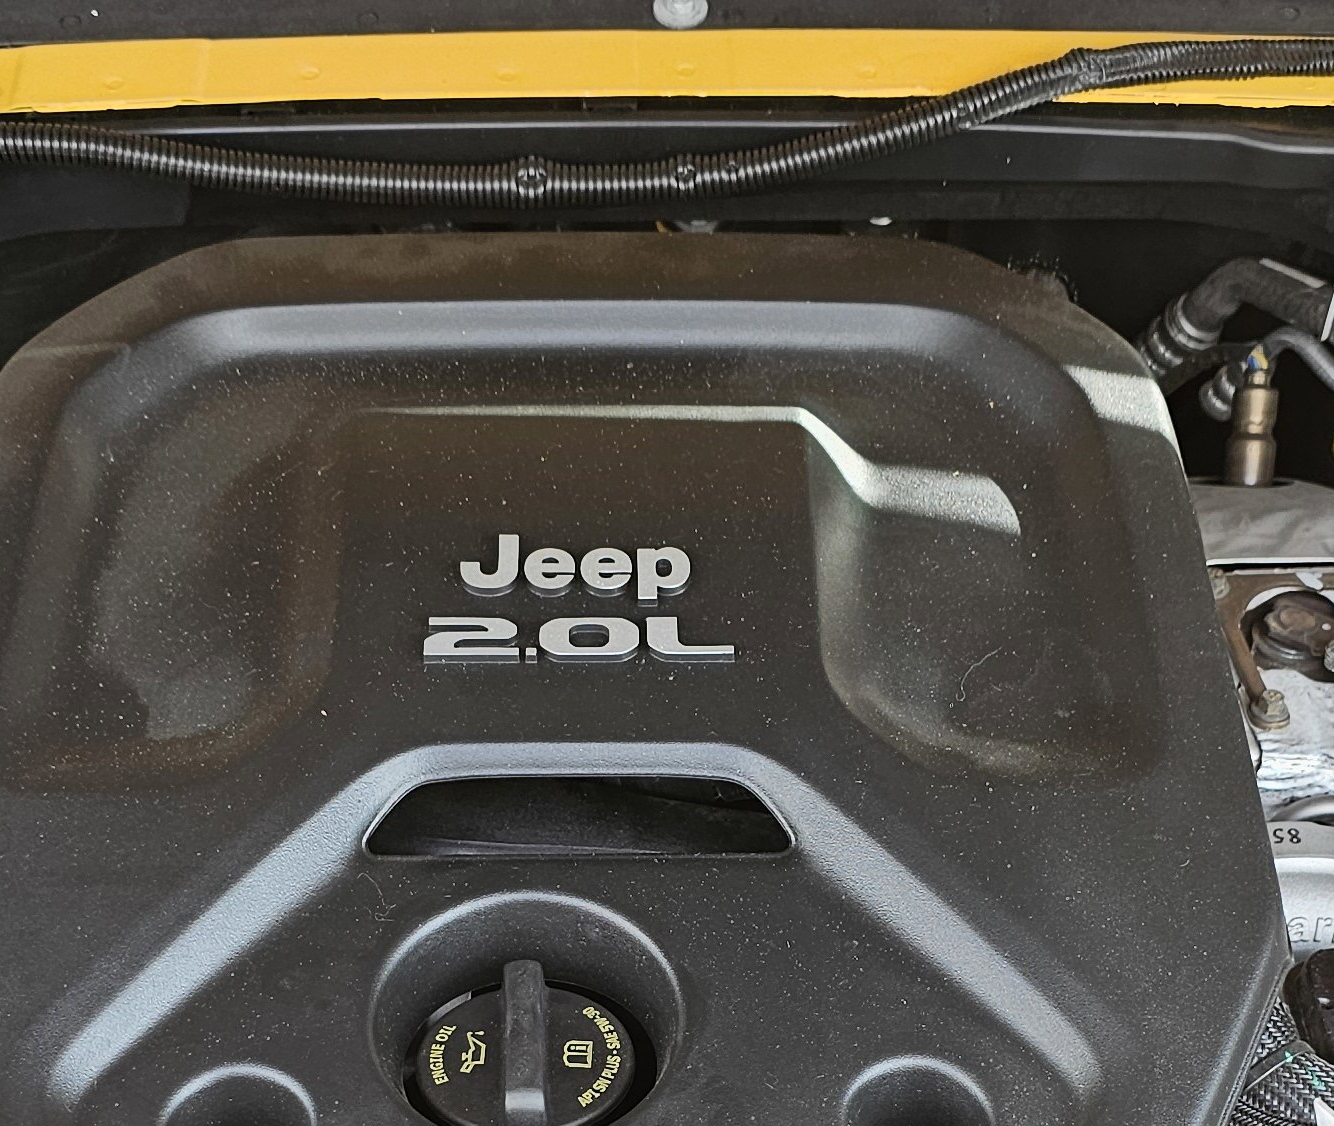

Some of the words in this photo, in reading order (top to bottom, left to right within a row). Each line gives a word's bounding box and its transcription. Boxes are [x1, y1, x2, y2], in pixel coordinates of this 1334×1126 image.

[460, 533, 691, 604] Jeep
[423, 616, 735, 663] 2.0L
[582, 1006, 615, 1034] 5W-30
[604, 1031, 621, 1050] SAE
[429, 1043, 450, 1085] ENGINE
[440, 1024, 457, 1043] OIL
[606, 1054, 621, 1079] PLUS
[595, 1077, 612, 1093] SN
[577, 1091, 597, 1108] API
